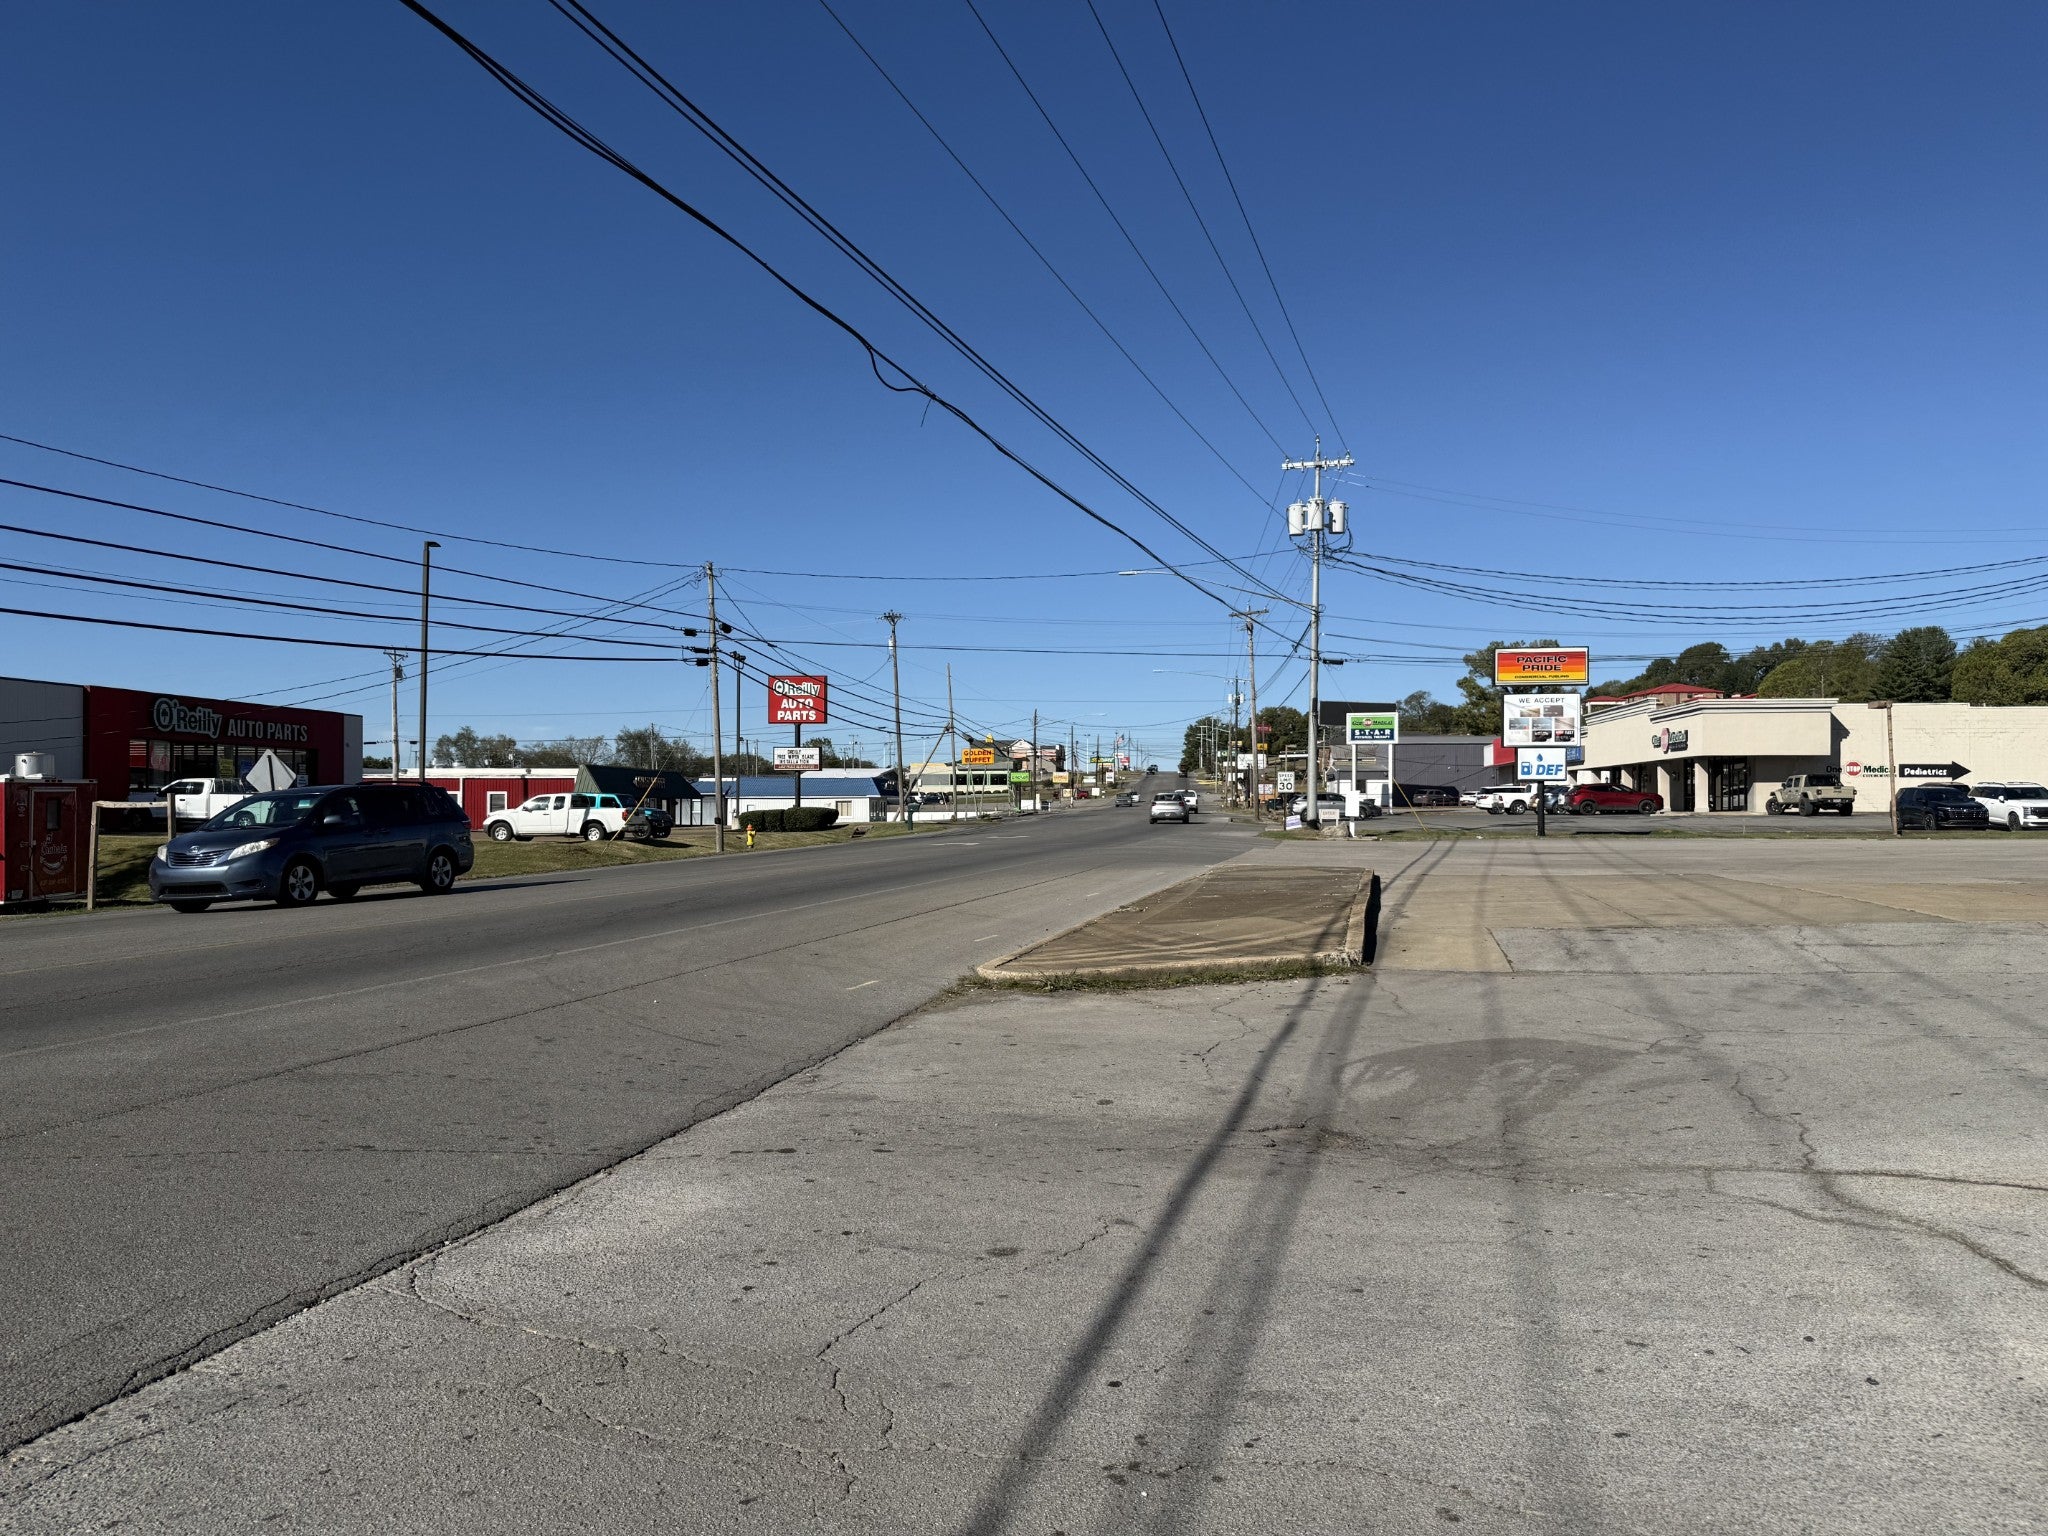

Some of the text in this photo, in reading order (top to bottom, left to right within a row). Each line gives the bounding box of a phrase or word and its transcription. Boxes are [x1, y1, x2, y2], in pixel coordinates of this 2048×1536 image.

[1516, 655, 1567, 663] PACIFIC
[773, 679, 821, 697] O'Reilly
[781, 699, 814, 709] AUTO
[154, 698, 308, 742] O'Reilly AUTO PARTS
[777, 711, 817, 721] PARTS
[1535, 764, 1564, 775] DEF
[1863, 765, 1896, 773] Medicl
[1904, 767, 1948, 776] Pediatrics
[1278, 782, 1293, 790] 30
